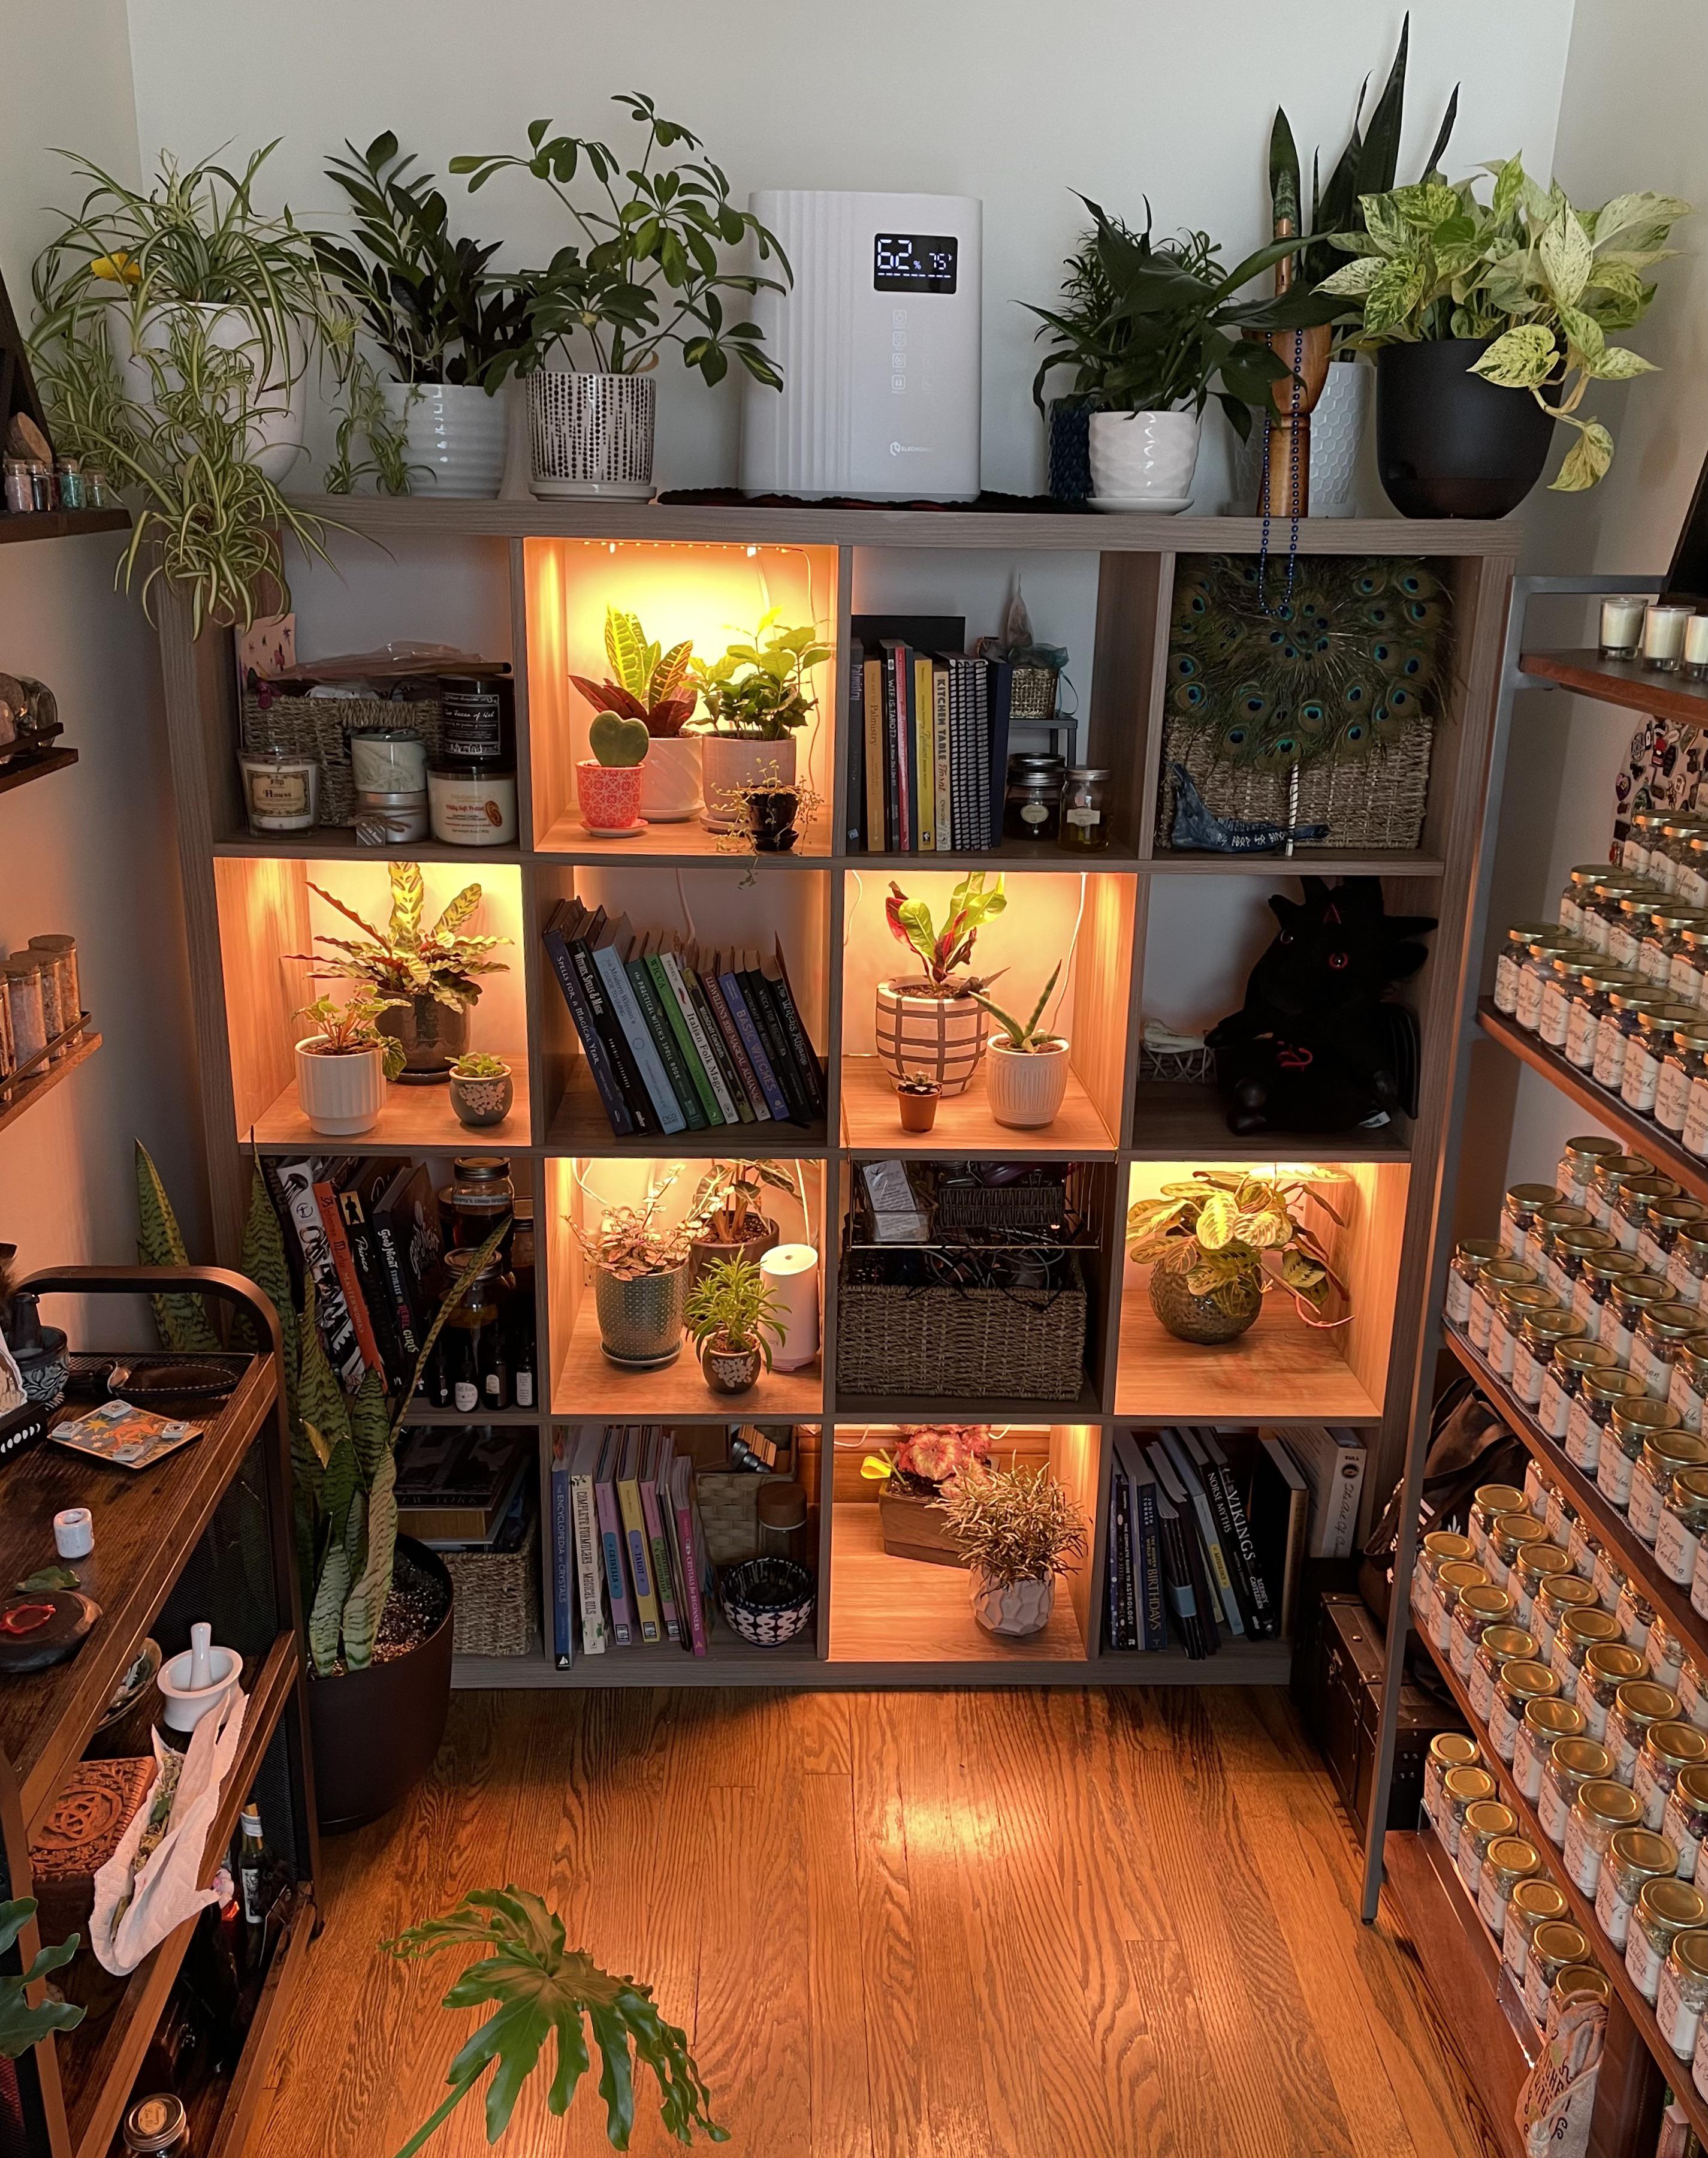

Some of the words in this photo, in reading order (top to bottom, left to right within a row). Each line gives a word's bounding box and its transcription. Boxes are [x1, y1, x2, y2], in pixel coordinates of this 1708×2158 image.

[877, 239, 912, 270] 62
[929, 252, 946, 270] 75
[850, 664, 863, 701] Palmistry
[889, 699, 895, 707] IS
[937, 679, 946, 725] KITCHEN
[870, 705, 879, 745] Palmistry
[938, 729, 946, 760] TABLE
[939, 764, 947, 792] Tarot
[650, 959, 665, 988] WICCA
[777, 983, 786, 998] The
[557, 956, 568, 981] SPELLS
[566, 982, 575, 999] FOR
[575, 1007, 592, 1042] MAGICAL
[589, 1043, 599, 1065] YEAR
[592, 997, 604, 1015] MAGIC
[604, 971, 616, 990] GUIDE
[611, 989, 618, 999] TO
[615, 997, 626, 1017] LIVING
[610, 966, 624, 995] Modern
[621, 994, 636, 1024] Wiccan's
[705, 976, 728, 1019] LLEWELLYN'S
[729, 1034, 746, 1066] MAGICAL
[742, 1068, 761, 1102] ALMANAC
[758, 989, 769, 1009] WICCA
[766, 1009, 775, 1021] FOR
[771, 1023, 787, 1056] BEGINNERS
[687, 1013, 703, 1042] Italian
[700, 1044, 713, 1065] Folk
[708, 1066, 723, 1093] Magic
[711, 1033, 725, 1059] Cocktails
[737, 1009, 756, 1042] BASIC
[751, 1042, 776, 1091] WITCHES
[669, 1062, 681, 1079] BOOK
[355, 1235, 369, 1273] Prince
[343, 1273, 364, 1334] MASTERWORKS
[390, 1270, 402, 1295] STORIES
[398, 1304, 412, 1329] REBEL
[434, 1495, 479, 1505] YORK
[1208, 1472, 1223, 1501] NORSE
[1217, 1503, 1232, 1533] MYTHS
[1344, 1483, 1354, 1500] The
[1227, 1490, 1256, 1560] VIKINGS
[1339, 1500, 1350, 1520] Art
[576, 1491, 589, 1526] COMPLETE
[585, 1601, 596, 1615] OILS
[1661, 1520, 1686, 1556] Lemon
[609, 1550, 619, 1583] CRYSTALS
[634, 1553, 644, 1574] TAROT
[686, 1556, 695, 1586] CRYSTALS
[1658, 1538, 1685, 1580] Verbena
[690, 1595, 701, 1631] BEGINNERS
[1147, 1568, 1161, 1630] BIRTHDAYS
